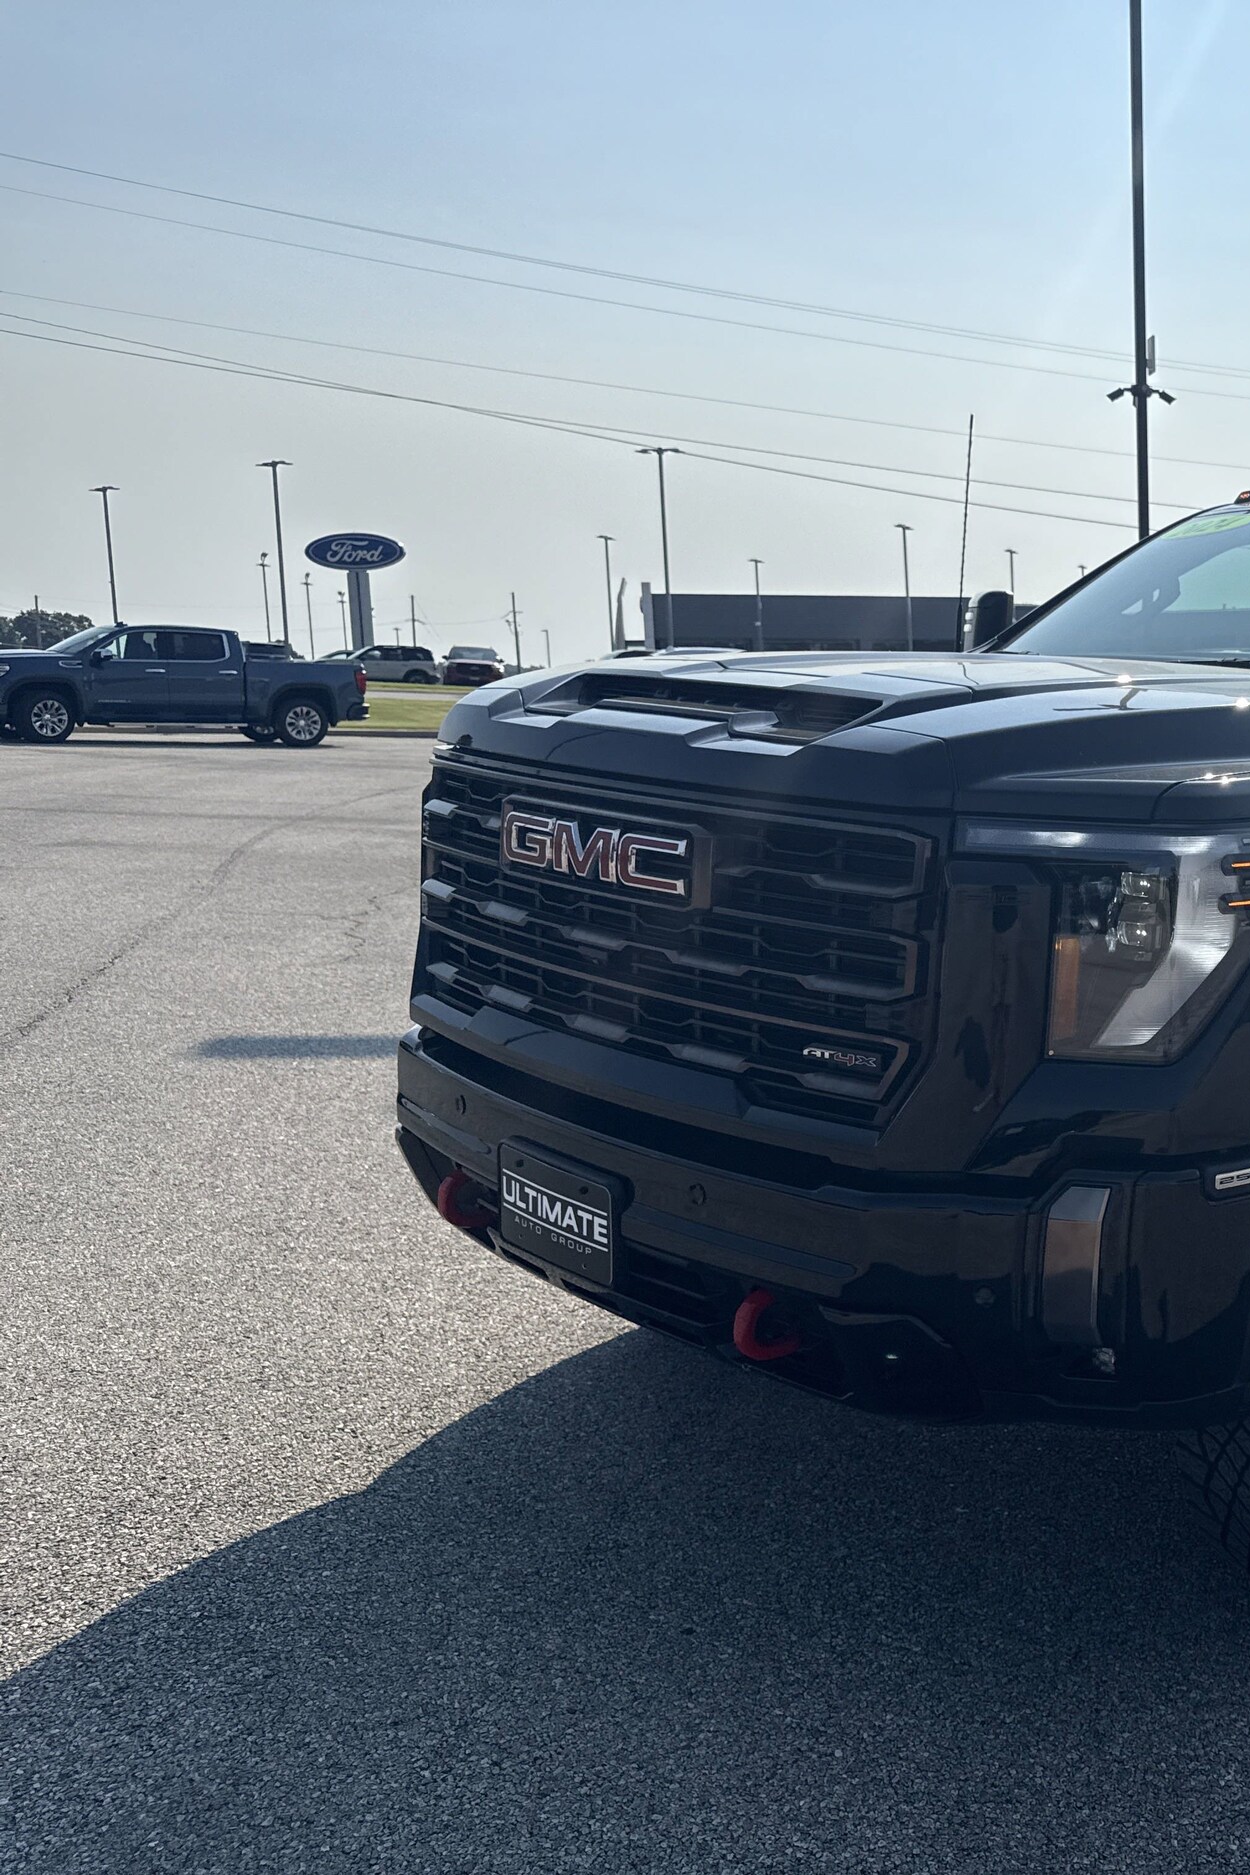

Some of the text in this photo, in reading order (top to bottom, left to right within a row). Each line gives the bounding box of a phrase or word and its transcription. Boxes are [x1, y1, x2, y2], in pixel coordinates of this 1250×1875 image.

[326, 540, 384, 562] Ford
[503, 811, 688, 897] GMC
[802, 1046, 877, 1068] AT4X
[502, 1175, 608, 1244] ULTIMATE
[514, 1215, 592, 1255] AUTO GROUP
